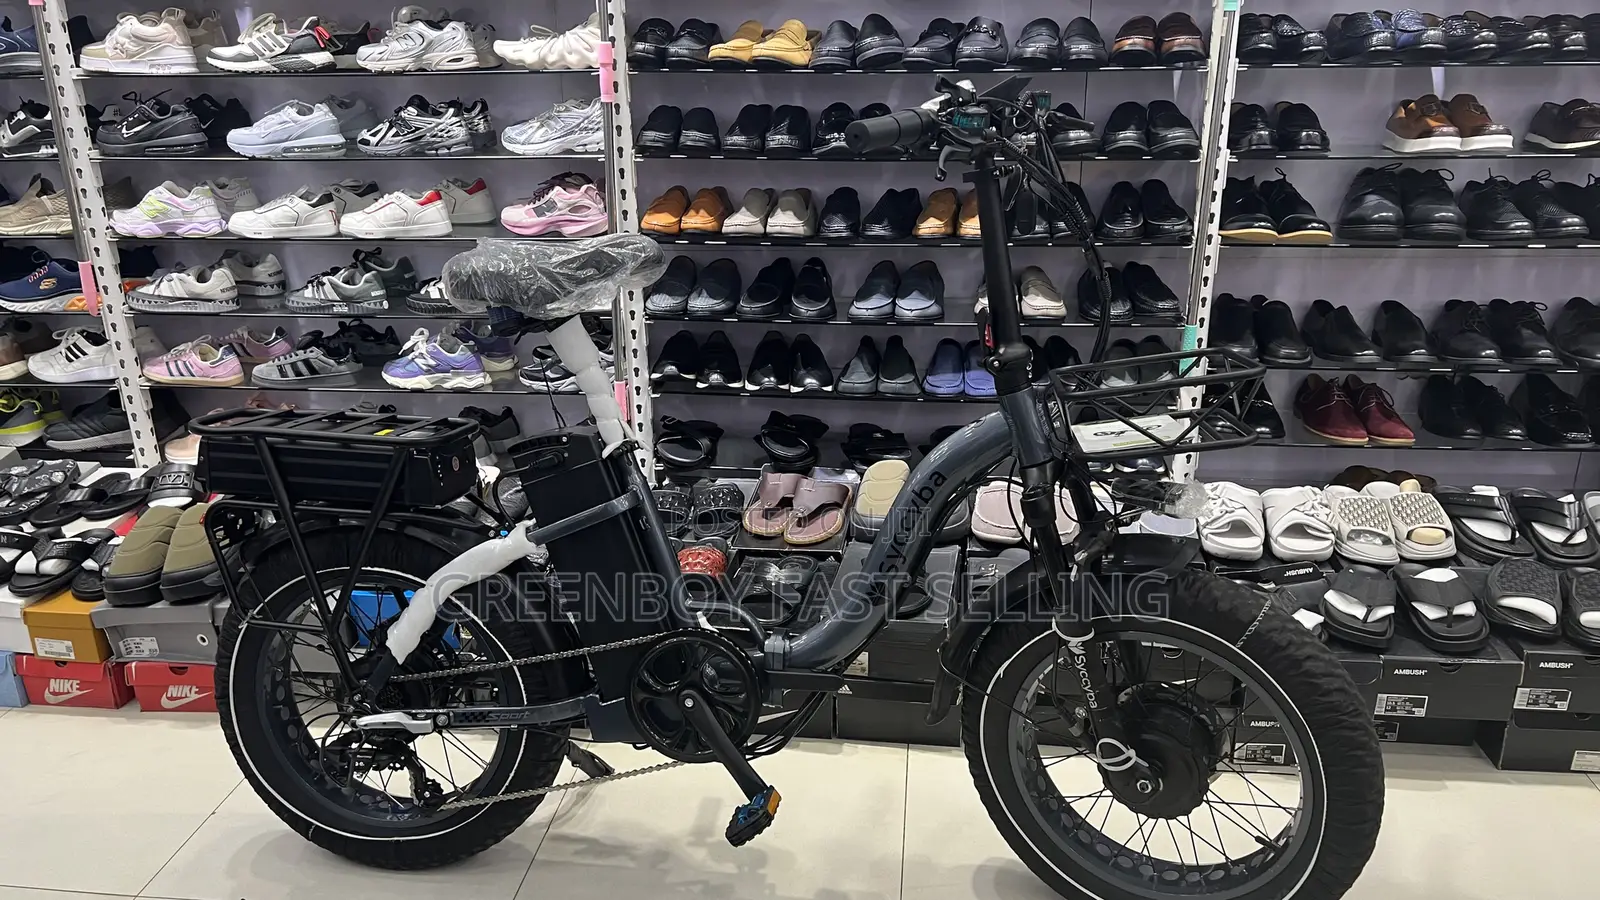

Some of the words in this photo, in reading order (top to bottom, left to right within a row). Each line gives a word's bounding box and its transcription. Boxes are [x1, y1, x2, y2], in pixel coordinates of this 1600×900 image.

[49, 679, 81, 693] NIKE
[1074, 655, 1098, 709] Syccyba
[167, 685, 200, 698] NIKE
